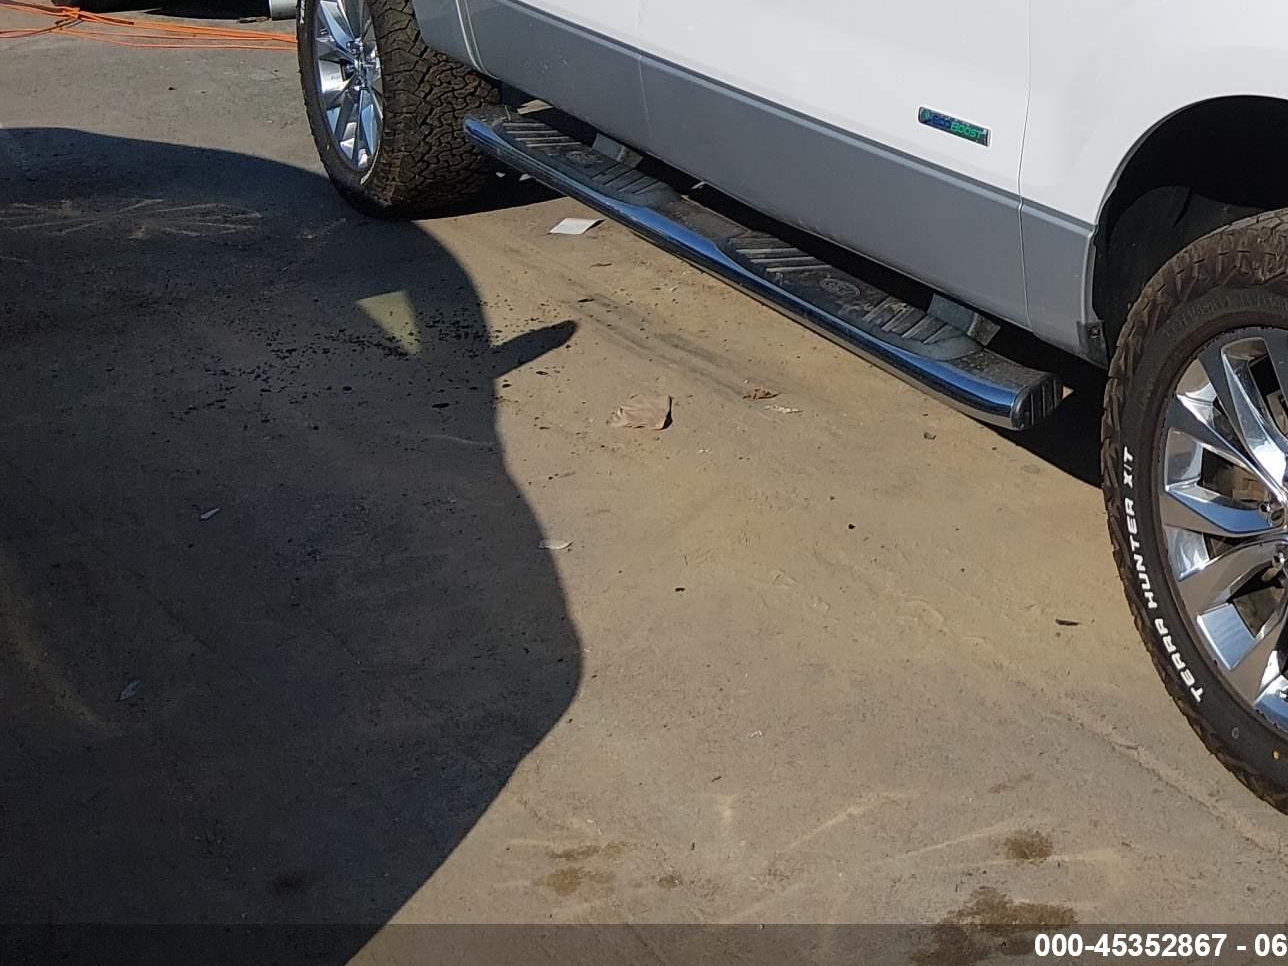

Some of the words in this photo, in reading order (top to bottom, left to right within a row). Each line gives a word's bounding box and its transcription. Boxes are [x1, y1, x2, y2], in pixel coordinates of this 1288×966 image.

[1123, 446, 1134, 488] X/T
[1124, 497, 1158, 609] HUNTER
[1154, 617, 1203, 703] TERRA
